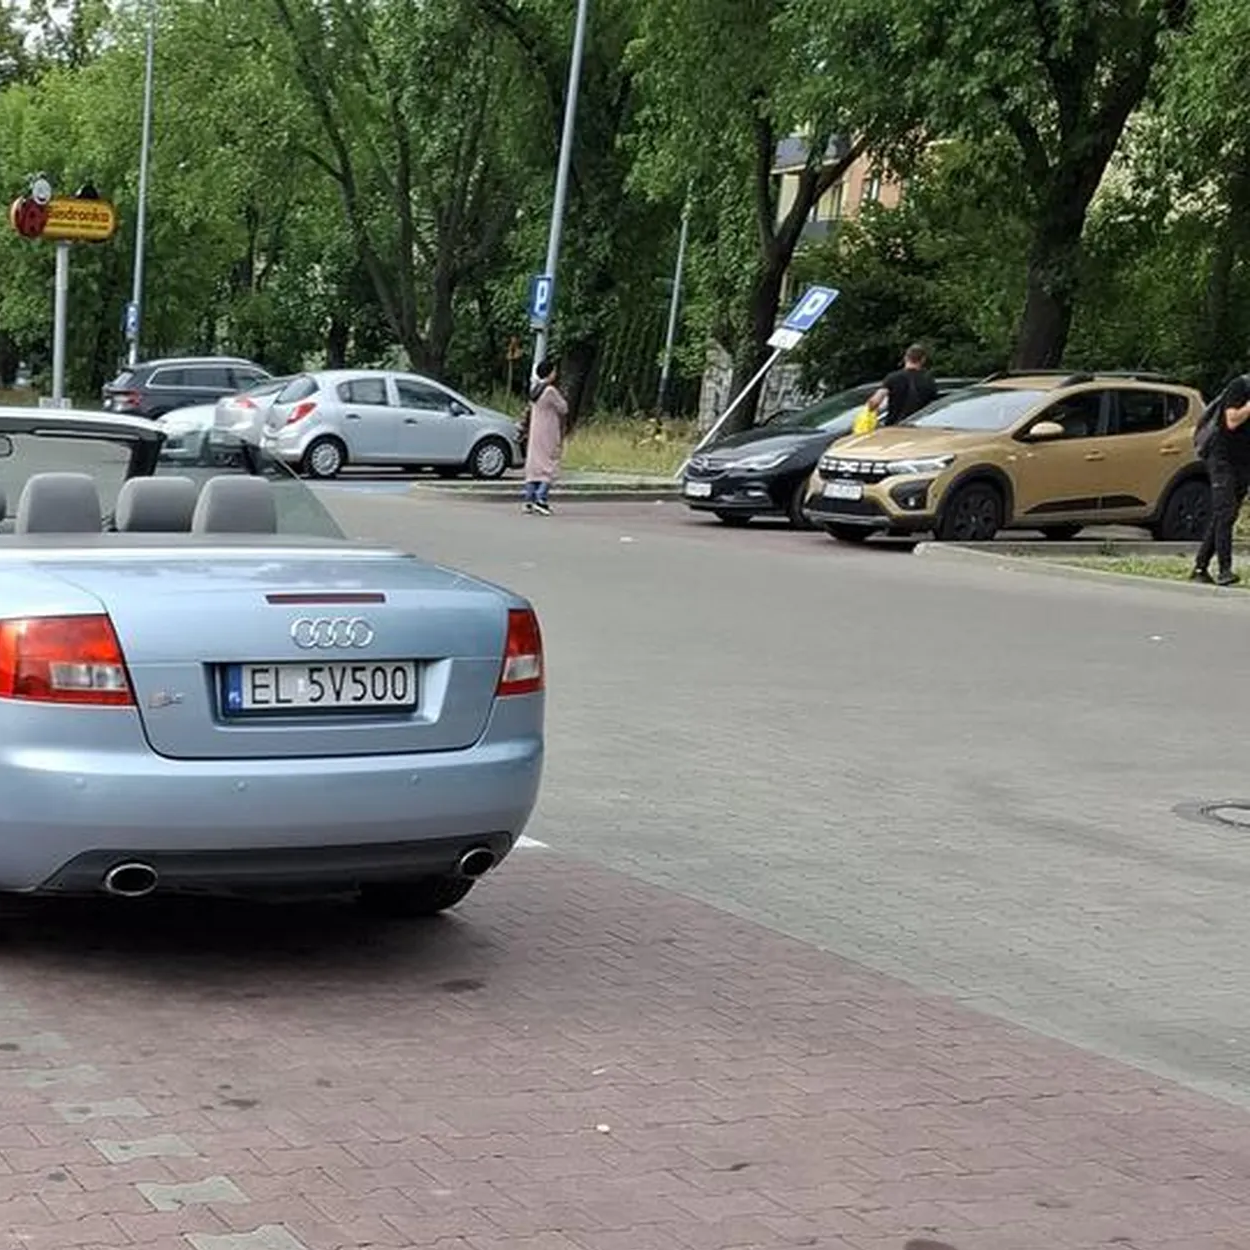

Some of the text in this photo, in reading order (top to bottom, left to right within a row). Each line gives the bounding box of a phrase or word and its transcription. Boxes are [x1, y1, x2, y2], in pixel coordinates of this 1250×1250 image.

[534, 280, 549, 313] P
[792, 291, 828, 321] P
[251, 666, 408, 704] EL 5V500
